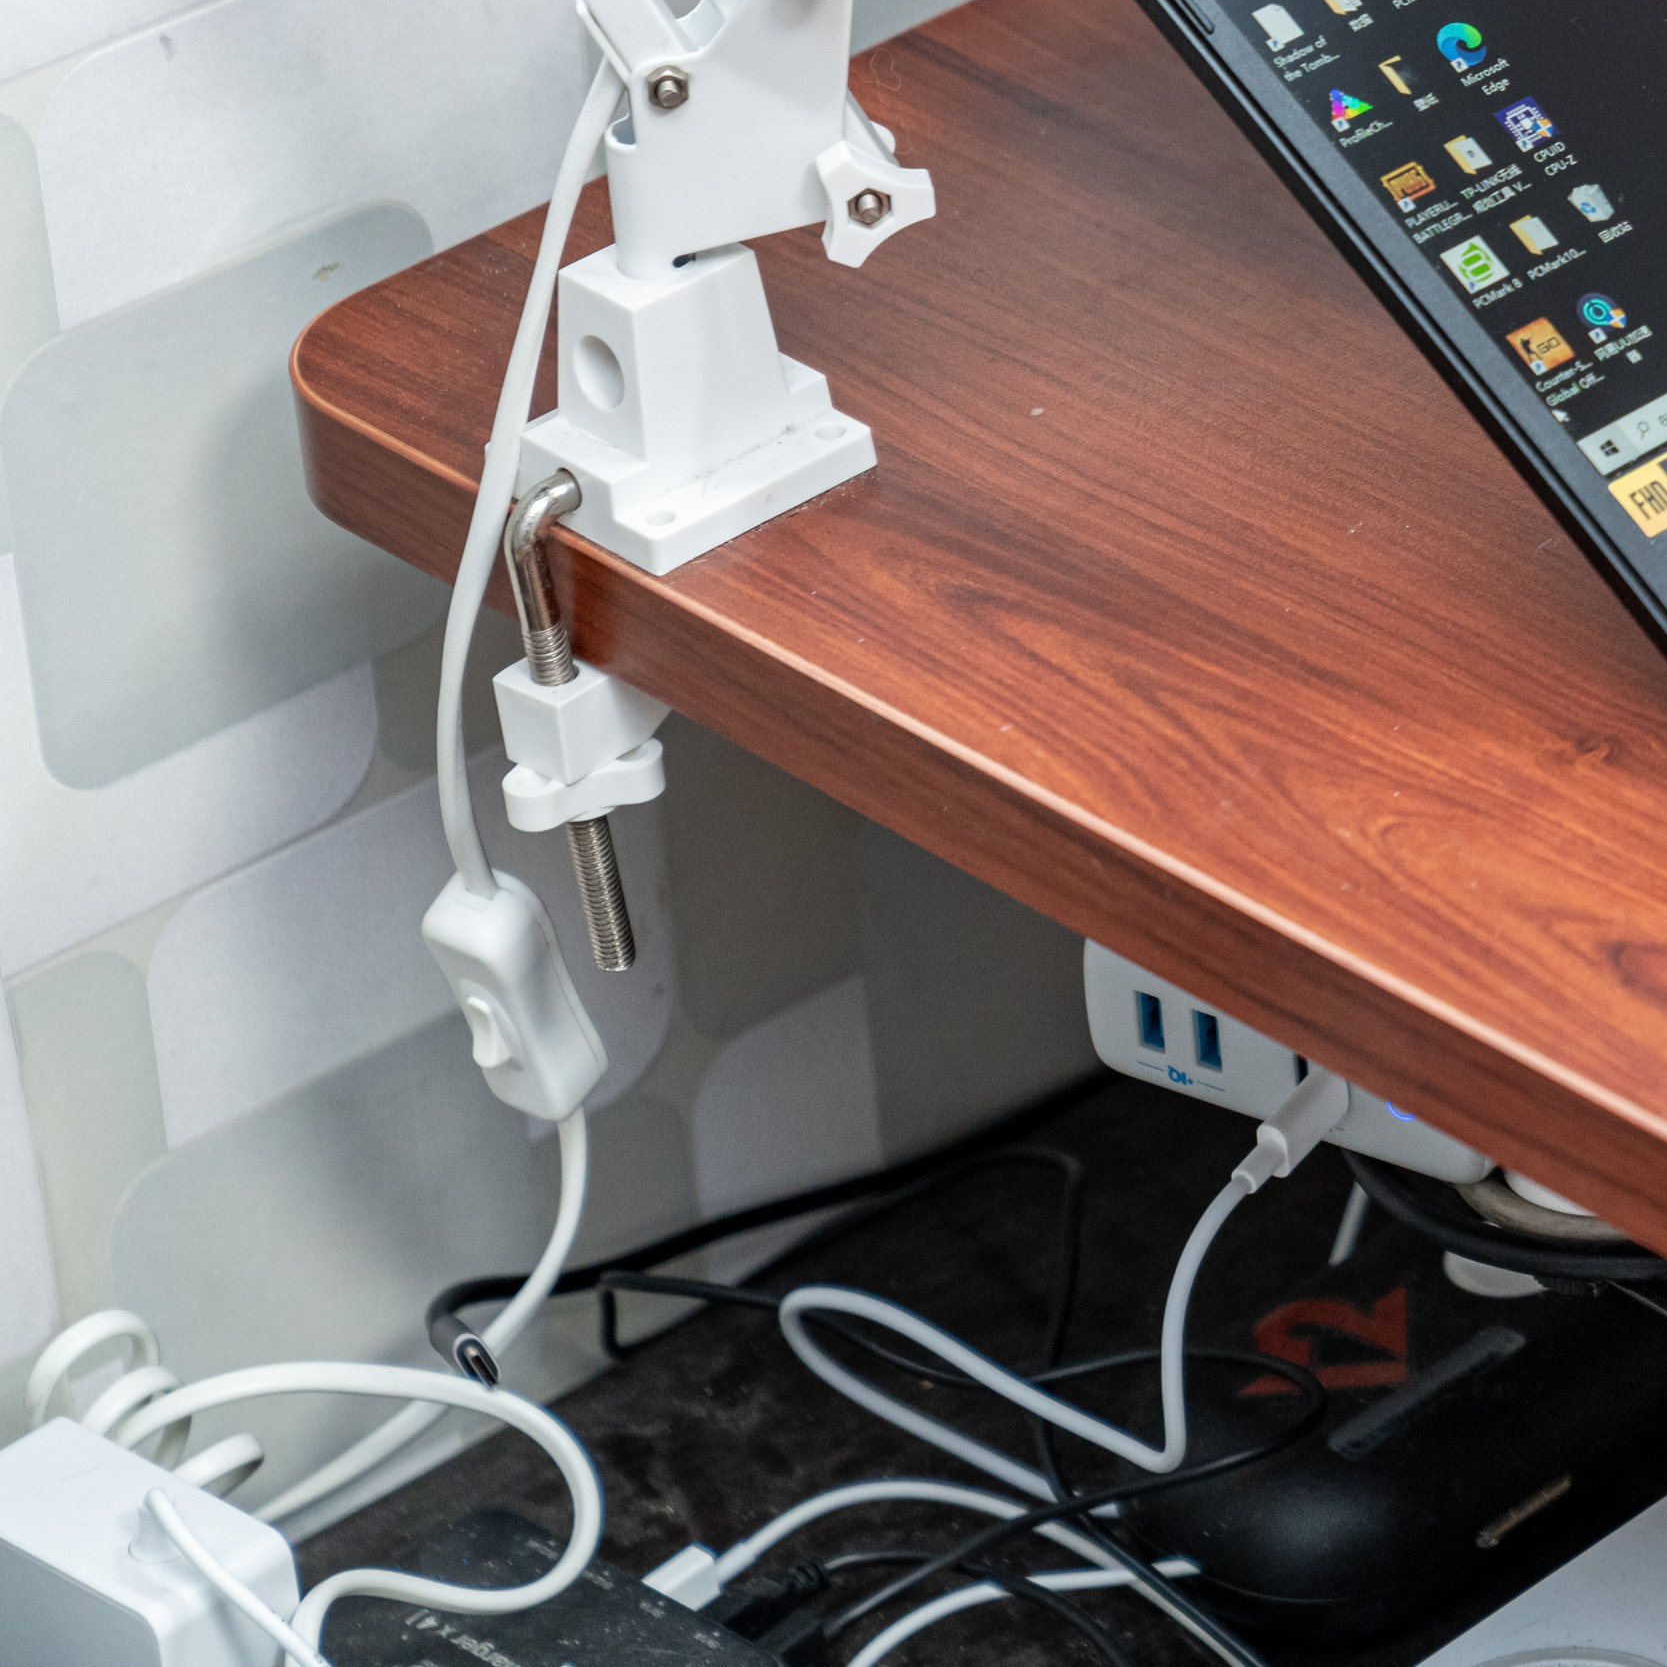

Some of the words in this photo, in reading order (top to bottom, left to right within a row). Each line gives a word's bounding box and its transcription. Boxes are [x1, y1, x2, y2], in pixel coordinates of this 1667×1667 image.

[1313, 34, 1328, 50] of
[1459, 57, 1511, 88] Microsoft
[1480, 77, 1511, 97] Edge
[1532, 140, 1567, 164] CPUID
[1543, 153, 1579, 177] CPU-Z
